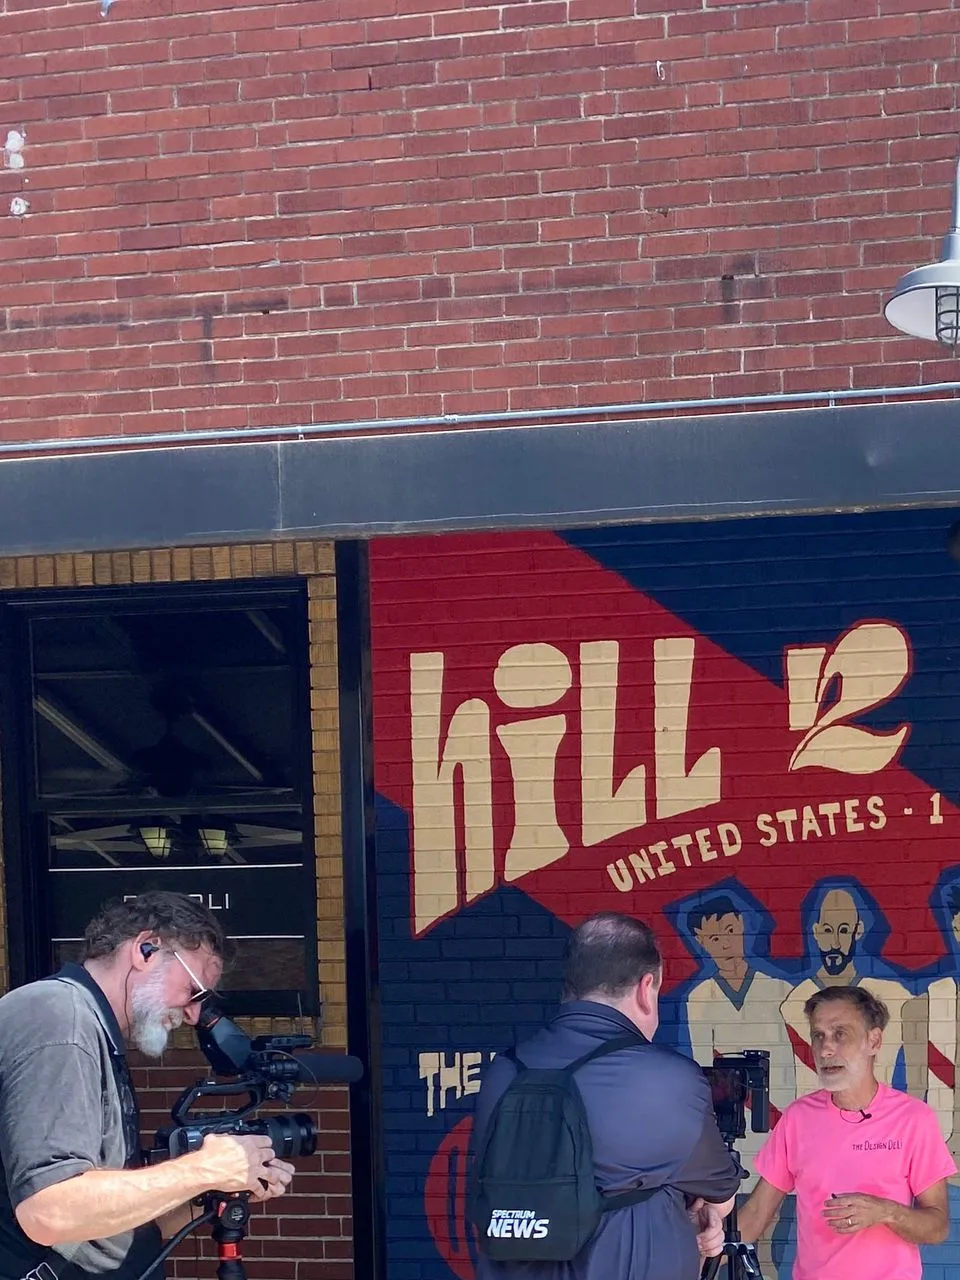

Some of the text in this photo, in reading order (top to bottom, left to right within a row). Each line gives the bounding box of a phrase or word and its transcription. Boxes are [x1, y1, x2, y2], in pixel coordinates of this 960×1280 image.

[787, 622, 911, 775] 2
[606, 822, 742, 893] UNITED
[756, 795, 888, 847] STATES
[929, 792, 944, 825] 1
[418, 1052, 482, 1117] THE
[486, 1218, 550, 1239] NEWS
[491, 1209, 536, 1219] SPECTRUM
